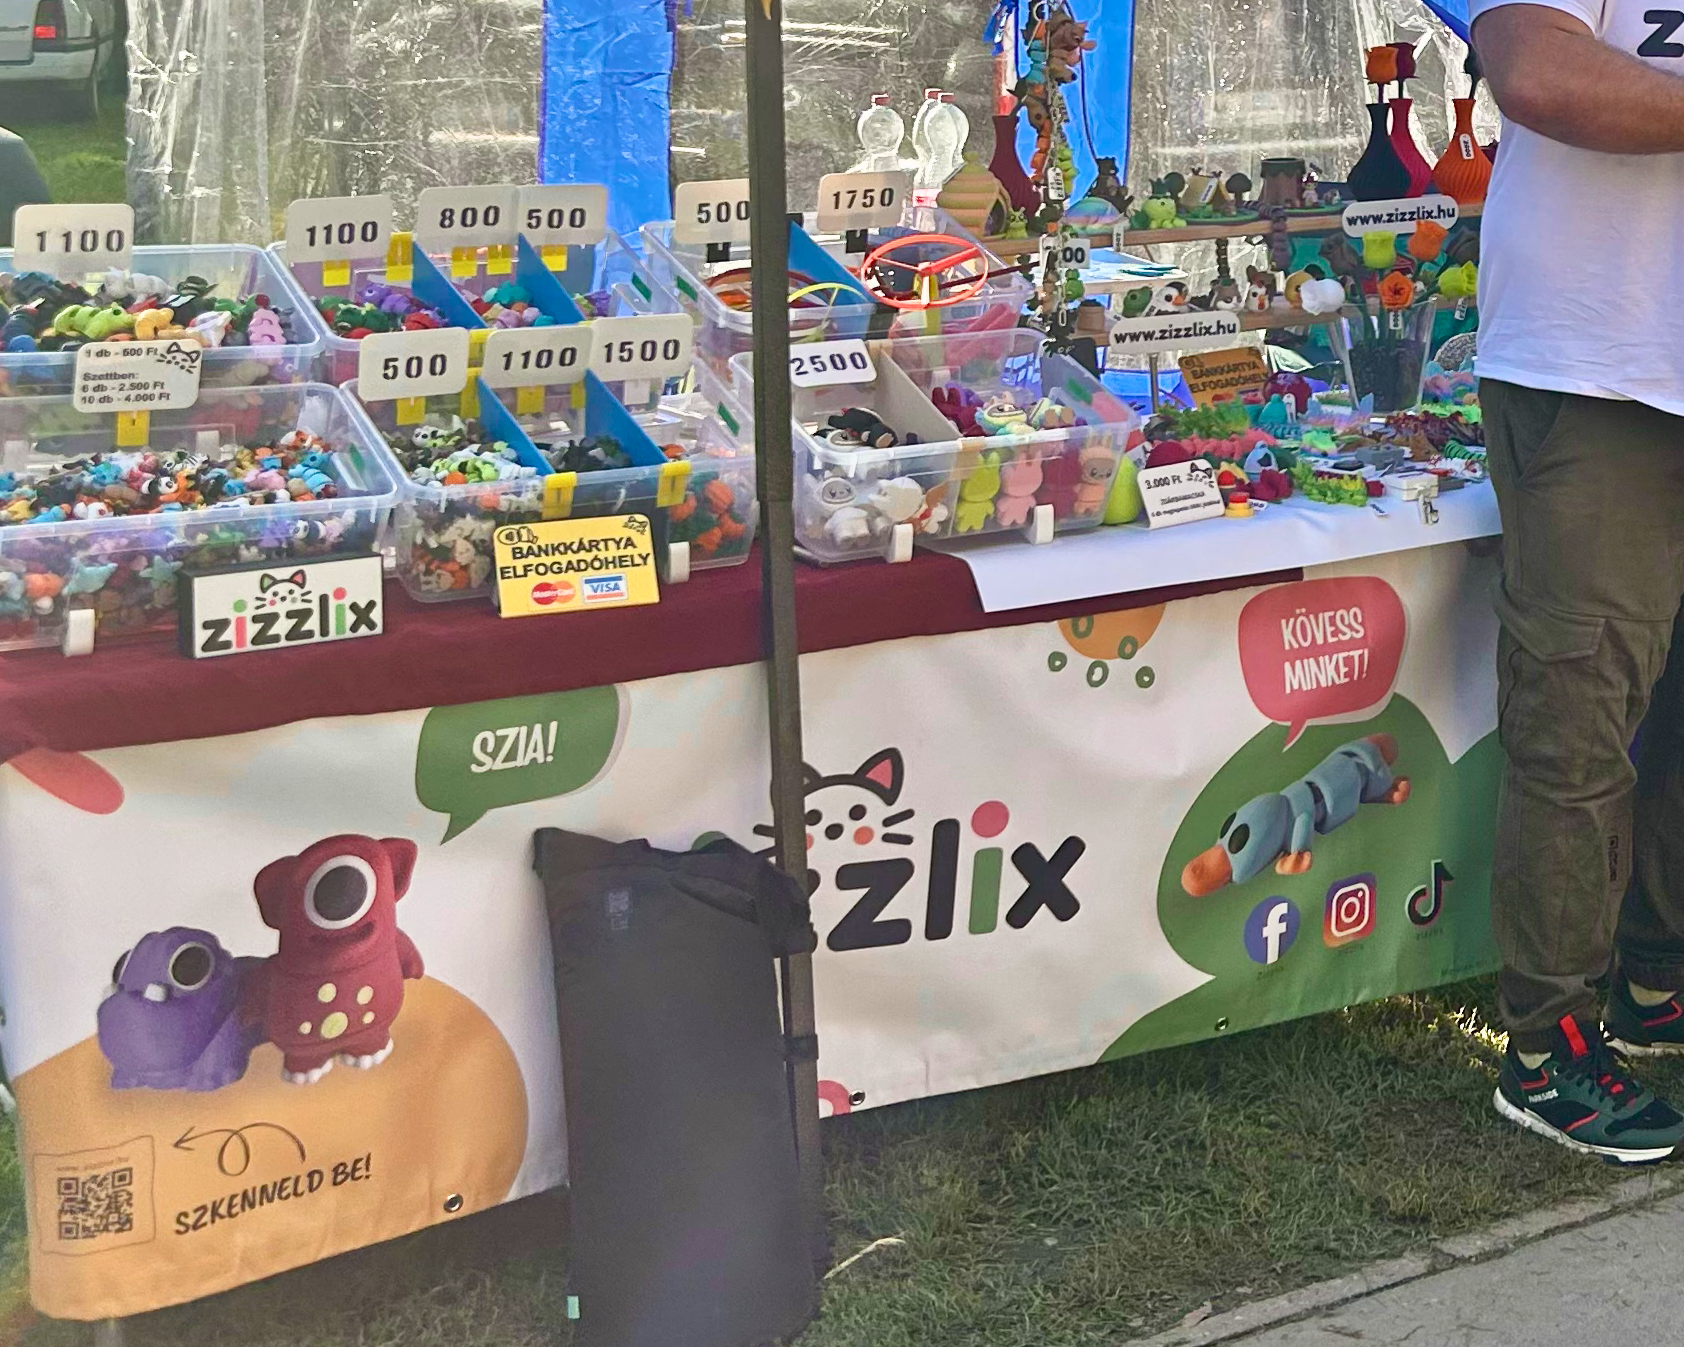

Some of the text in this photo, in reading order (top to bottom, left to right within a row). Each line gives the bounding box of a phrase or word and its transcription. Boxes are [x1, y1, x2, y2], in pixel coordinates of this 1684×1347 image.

[832, 187, 895, 210] 1750
[439, 205, 500, 229] 800
[527, 207, 587, 230] 500
[697, 200, 751, 224] 500
[1346, 205, 1457, 227] www.zizzlix.hu
[37, 229, 125, 252] 1100
[306, 221, 379, 247] 1100
[1113, 318, 1236, 344] www.zizzlix.hu
[146, 347, 158, 356] Ft
[502, 346, 578, 371] 1100
[604, 338, 681, 363] 1500
[382, 353, 447, 380] 500
[790, 351, 869, 375] 2500
[93, 384, 108, 392] db
[118, 382, 150, 392] 2.500
[153, 381, 165, 390] Ft
[98, 395, 113, 404] db
[124, 394, 155, 403] 4.000
[159, 393, 171, 401] Ft
[511, 536, 638, 560] BANKKÁRTYA
[500, 553, 651, 580] ELFOGADÓHELY
[590, 582, 622, 593] VISA
[201, 587, 378, 652] zizzlix
[1281, 605, 1365, 650] KÖVESS
[1284, 648, 1370, 695] MINKET!
[470, 721, 557, 773] SZIA!
[803, 800, 1086, 953] zlix
[175, 1153, 372, 1236] SZKENNELD BE!
